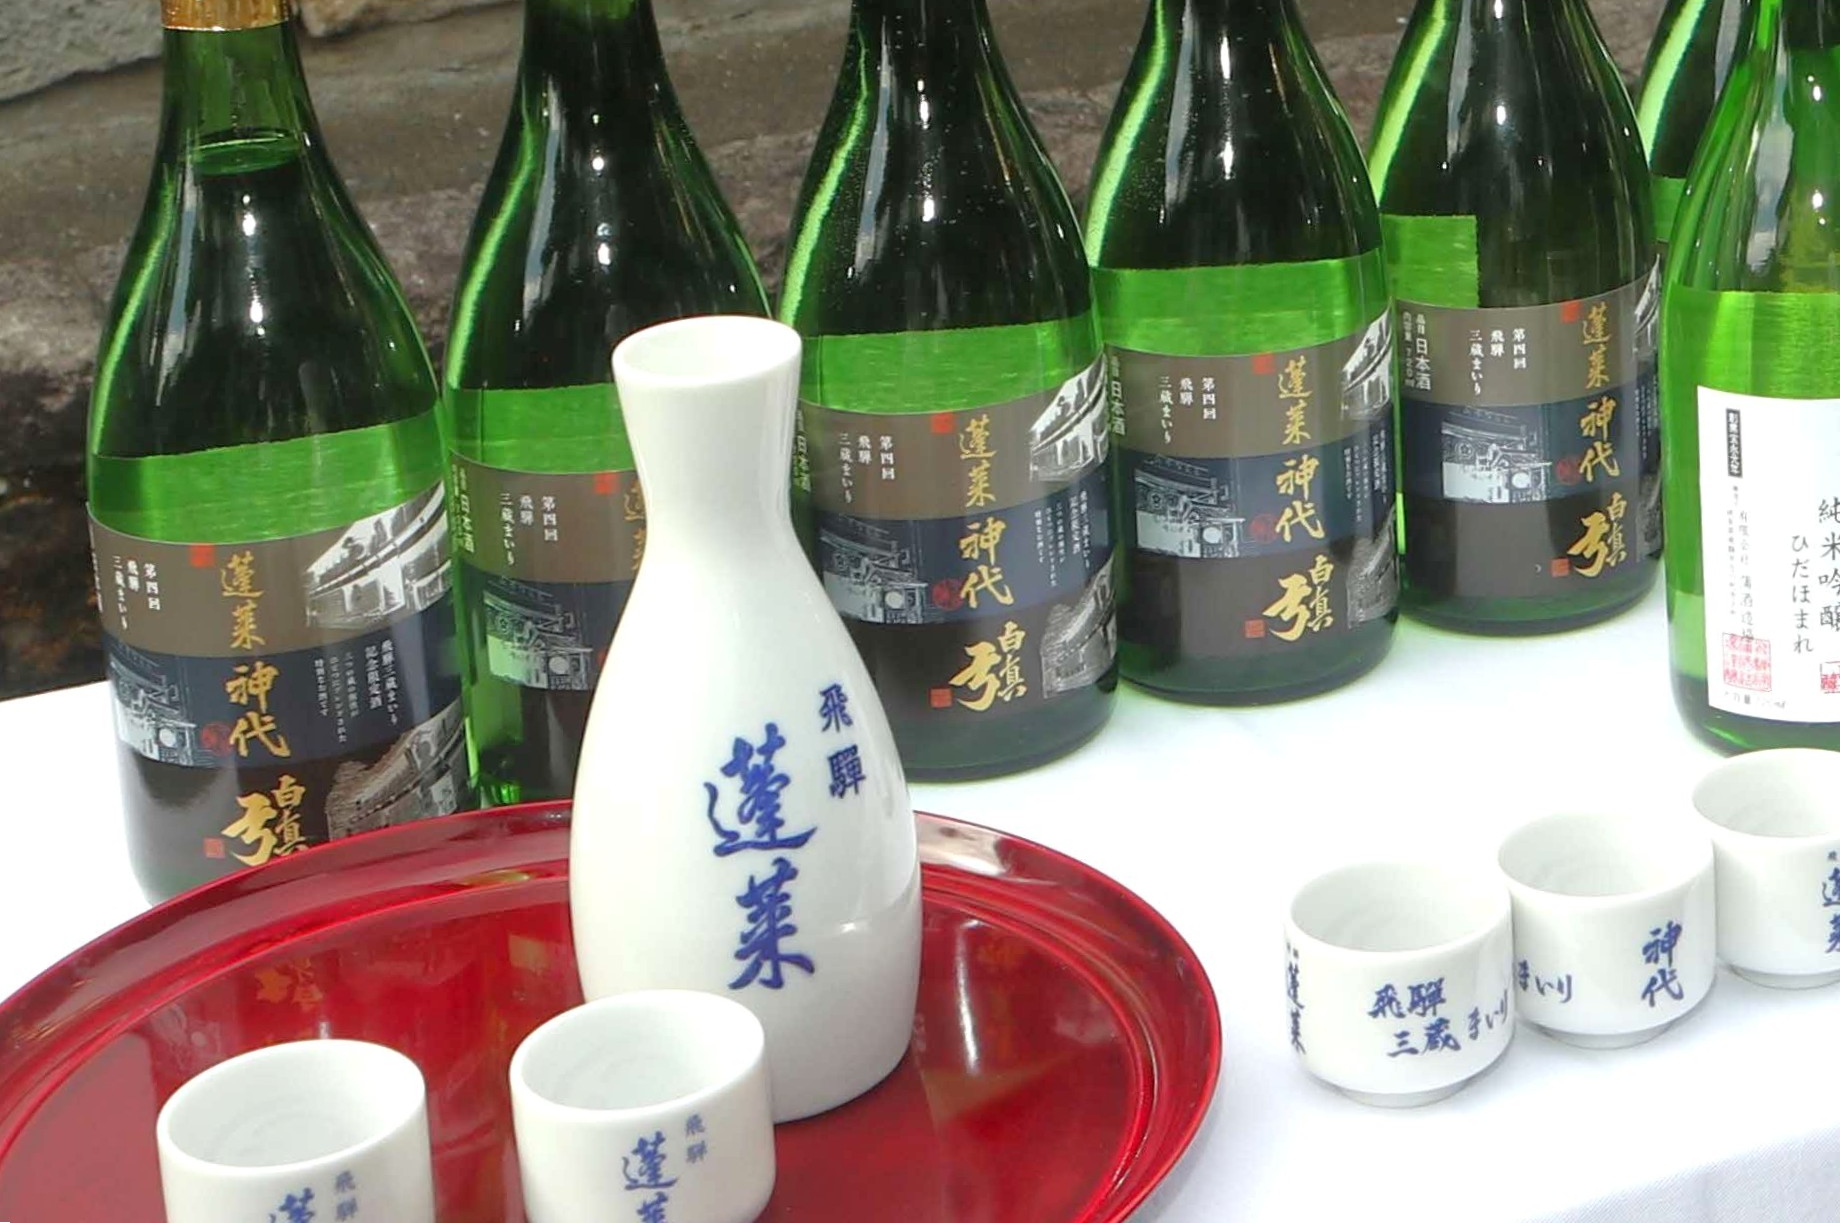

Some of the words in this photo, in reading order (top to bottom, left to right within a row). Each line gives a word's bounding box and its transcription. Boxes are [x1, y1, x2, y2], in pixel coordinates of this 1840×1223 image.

[1415, 337, 1431, 391] 日本酒
[1468, 329, 1484, 396] 三蔵まいり
[1583, 301, 1613, 389] 蓬莱
[1277, 355, 1313, 445] 蓬莱
[1580, 396, 1621, 482] 神代
[958, 413, 998, 508] 蓬莱
[1275, 454, 1326, 543] 神代
[221, 550, 265, 651] 蓬莱
[959, 519, 1015, 609] 神代
[1262, 555, 1335, 642] 白真弓
[1791, 533, 1815, 654] ひだほまれ
[225, 660, 291, 759] 神代
[949, 619, 1028, 712] 白真弓
[221, 774, 307, 868] 白真弓
[703, 721, 819, 991] 蓬莱
[1641, 921, 1684, 1007] 神代
